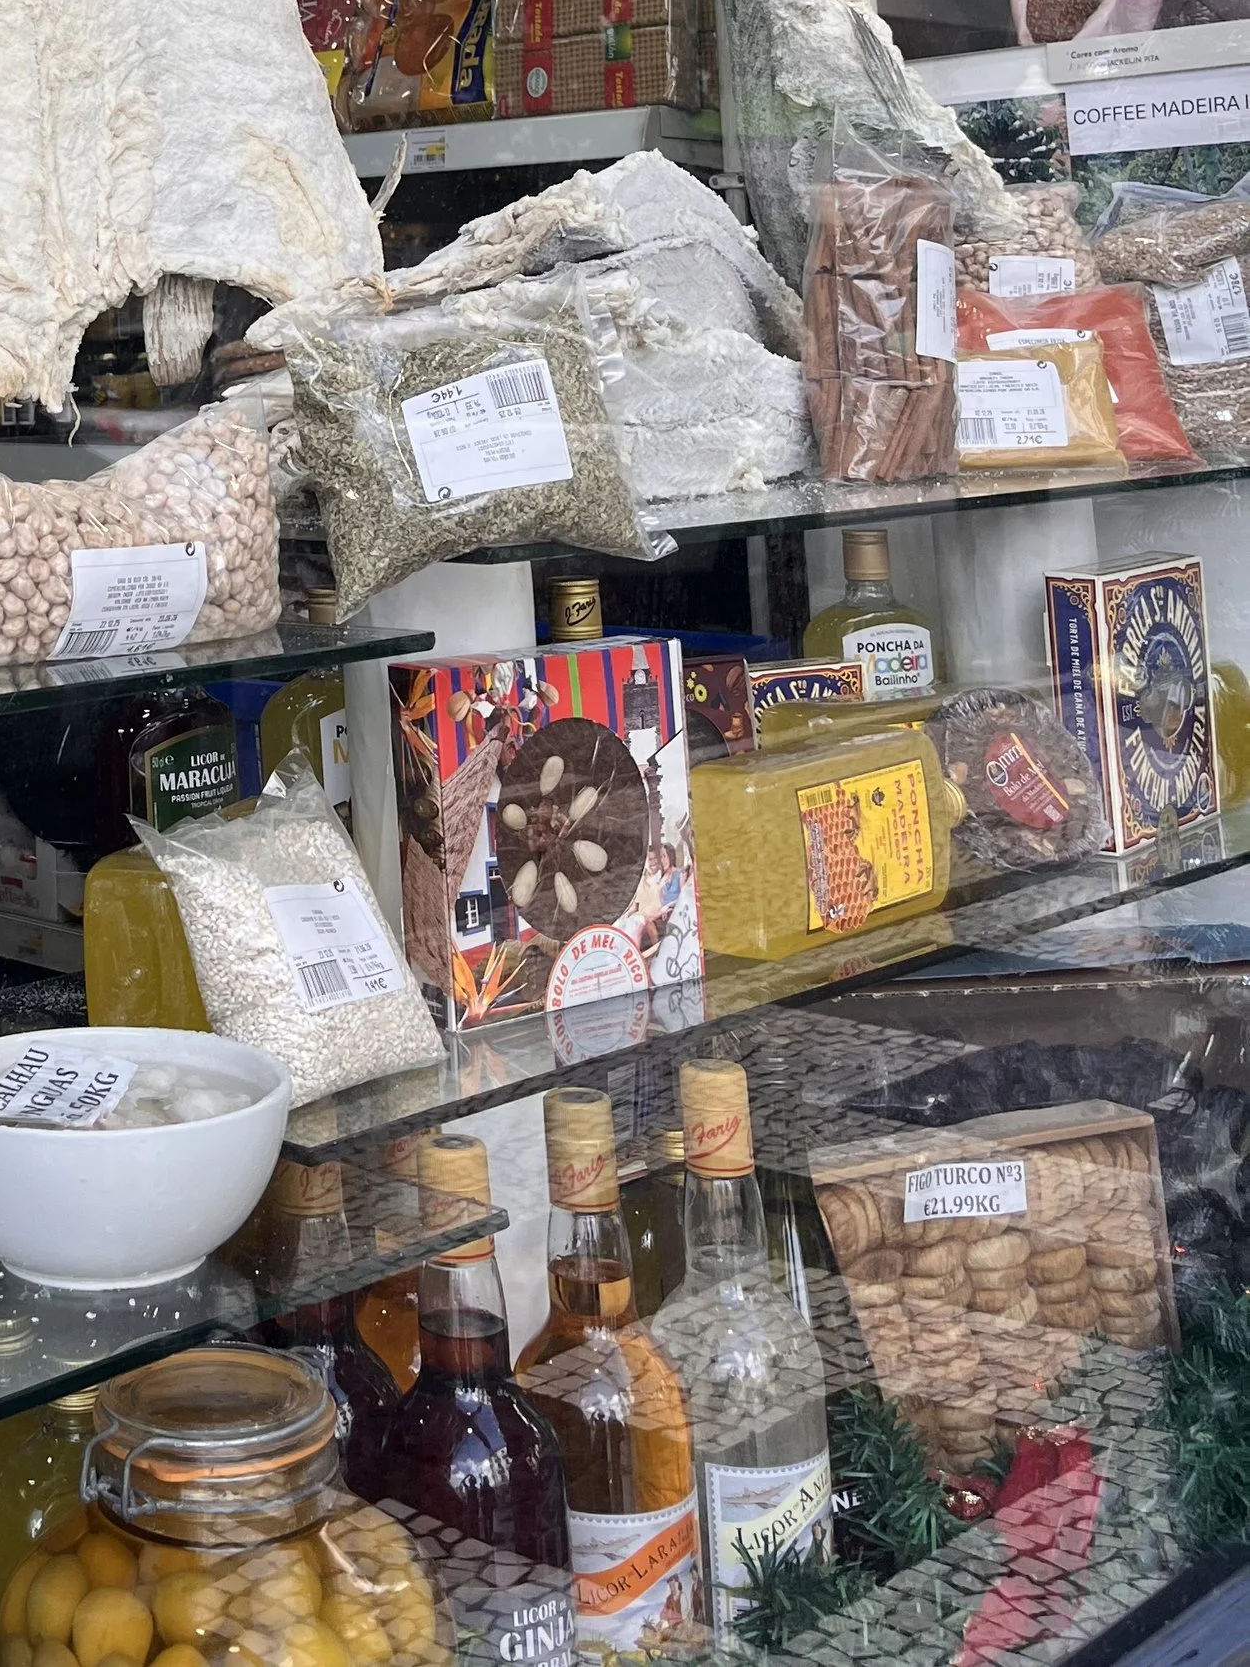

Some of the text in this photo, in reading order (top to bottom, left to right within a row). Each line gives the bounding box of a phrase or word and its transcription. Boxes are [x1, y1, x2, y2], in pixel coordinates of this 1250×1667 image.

[534, 1, 543, 43] Tostada
[606, 27, 616, 60] gullón
[1073, 103, 1146, 125] COFFEE
[1151, 95, 1241, 119] MADEIRA
[1068, 617, 1079, 645] TORTA
[857, 639, 925, 654] PONCHA DA
[1070, 645, 1079, 657] DE
[875, 672, 918, 686] Bailinho
[1071, 658, 1081, 678] MIEL
[1073, 679, 1082, 691] DE
[1076, 715, 1085, 727] DE
[191, 751, 219, 767] LICOR
[171, 790, 200, 803] PASSION
[201, 787, 217, 799] FRUIT
[1003, 781, 1022, 797] Bolo
[1020, 773, 1031, 784] de
[894, 779, 911, 884] MADEIRA
[907, 773, 924, 885] PONCHA
[552, 963, 569, 1007] BOLO
[571, 938, 587, 960] DE
[591, 934, 616, 951] MEL
[623, 949, 643, 983] RICO
[908, 1164, 1023, 1194] FIGO TURCO Nº3
[923, 1194, 1001, 1217] €21.99KG
[577, 1576, 633, 1606] LICOR
[513, 1599, 557, 1628] LICOR
[500, 1609, 575, 1662] GINJA
